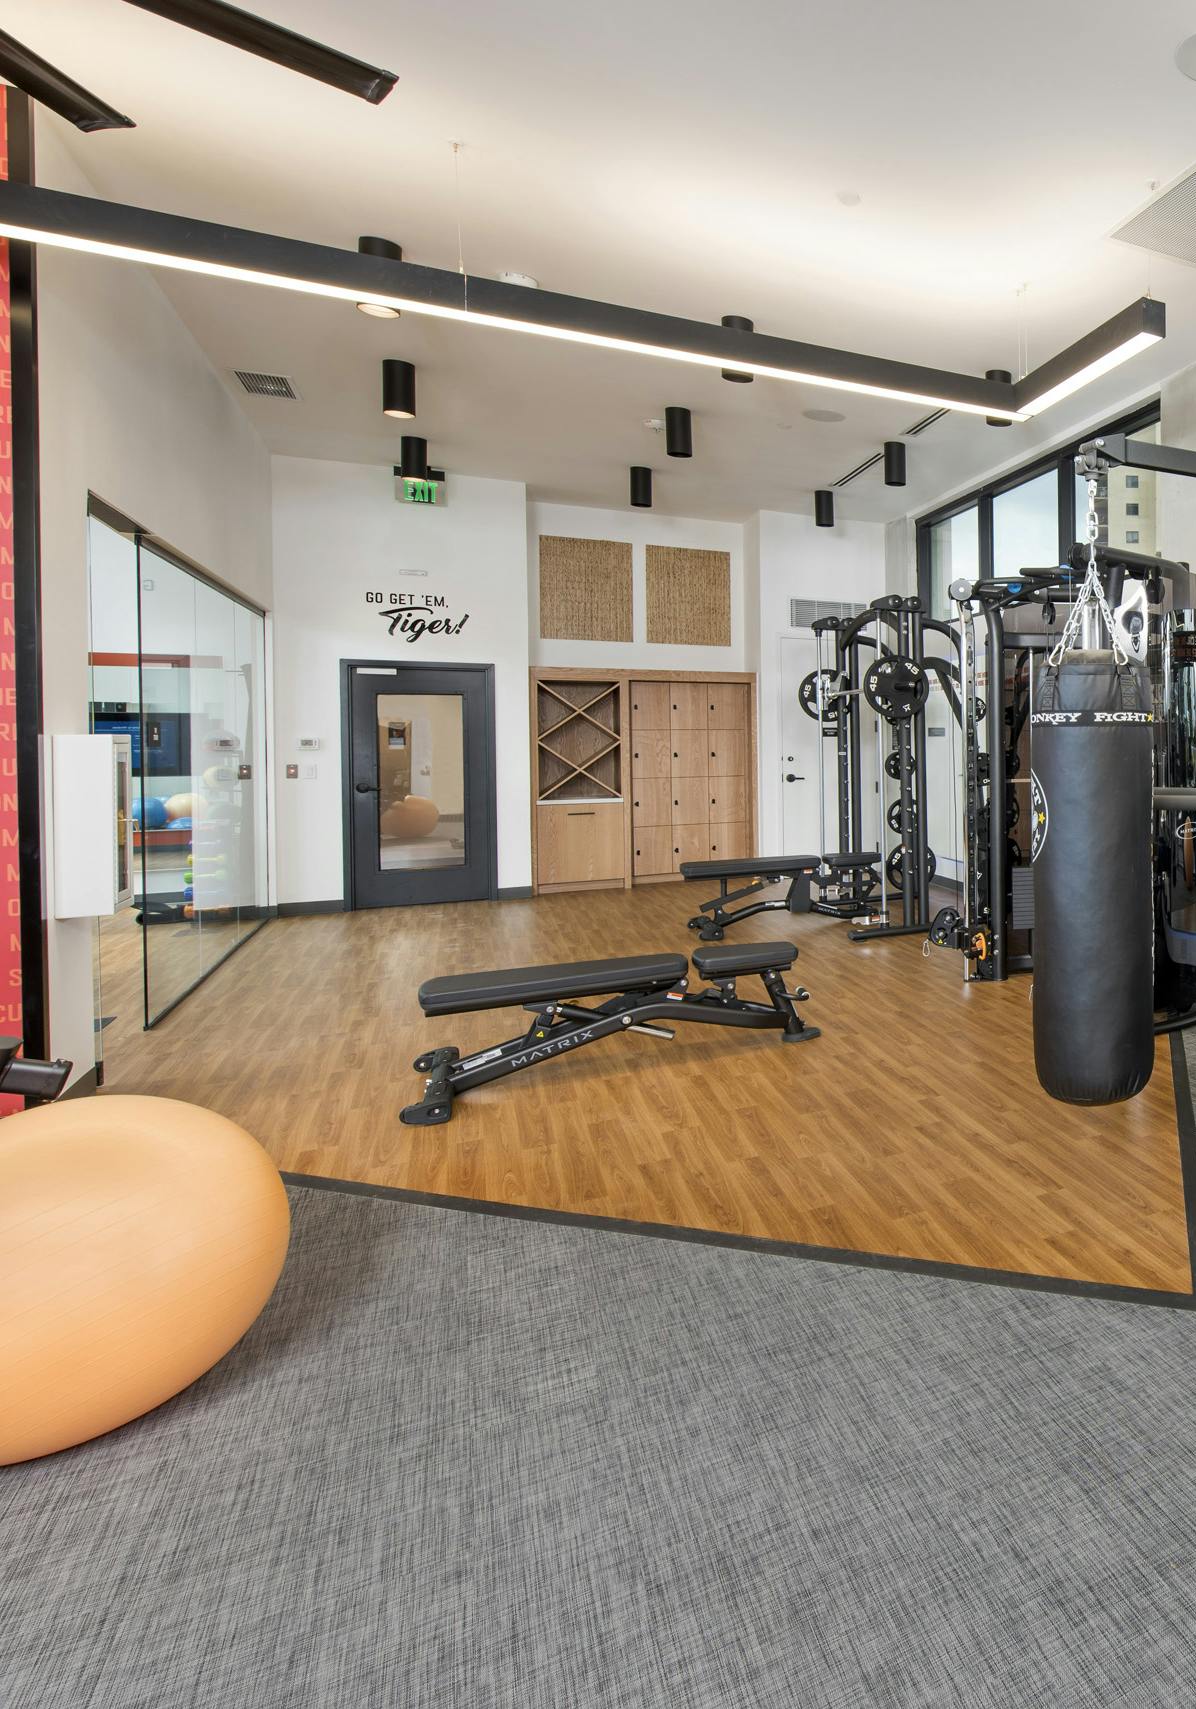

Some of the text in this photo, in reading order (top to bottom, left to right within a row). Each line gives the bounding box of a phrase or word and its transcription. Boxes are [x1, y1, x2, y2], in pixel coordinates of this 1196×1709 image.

[404, 479, 438, 502] EXIT
[366, 592, 383, 603] GO
[390, 593, 415, 605] GET
[378, 606, 470, 643] Tiger!
[904, 662, 919, 675] 45
[804, 684, 812, 697] 45
[869, 676, 877, 691] 45
[1032, 712, 1082, 725] ONKEY
[511, 1030, 593, 1067] MATRIX
